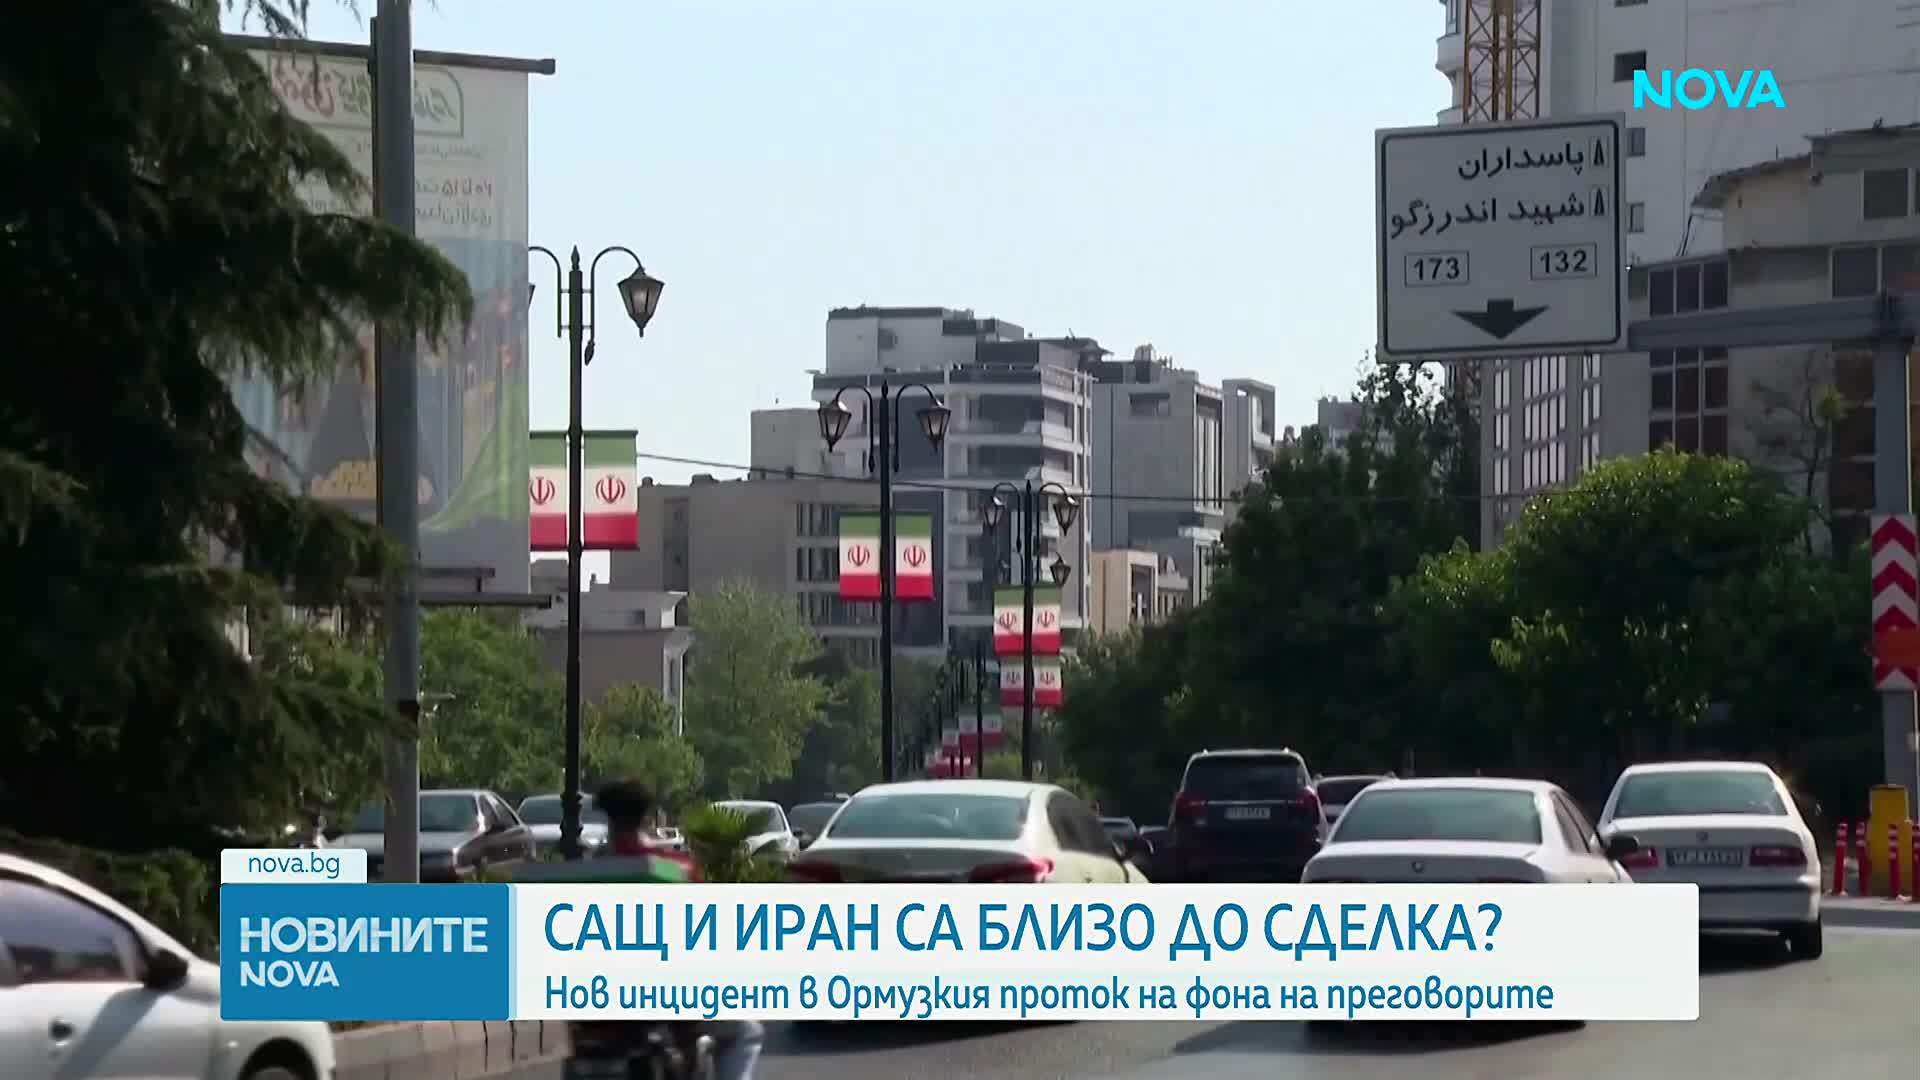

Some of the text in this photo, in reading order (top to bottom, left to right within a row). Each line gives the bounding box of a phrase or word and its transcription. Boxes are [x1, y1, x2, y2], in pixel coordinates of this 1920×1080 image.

[1458, 142, 1584, 180] پاسداران
[1391, 193, 1585, 240] شهید اندرزگو
[1414, 257, 1460, 281] 173
[1540, 250, 1588, 274] 132
